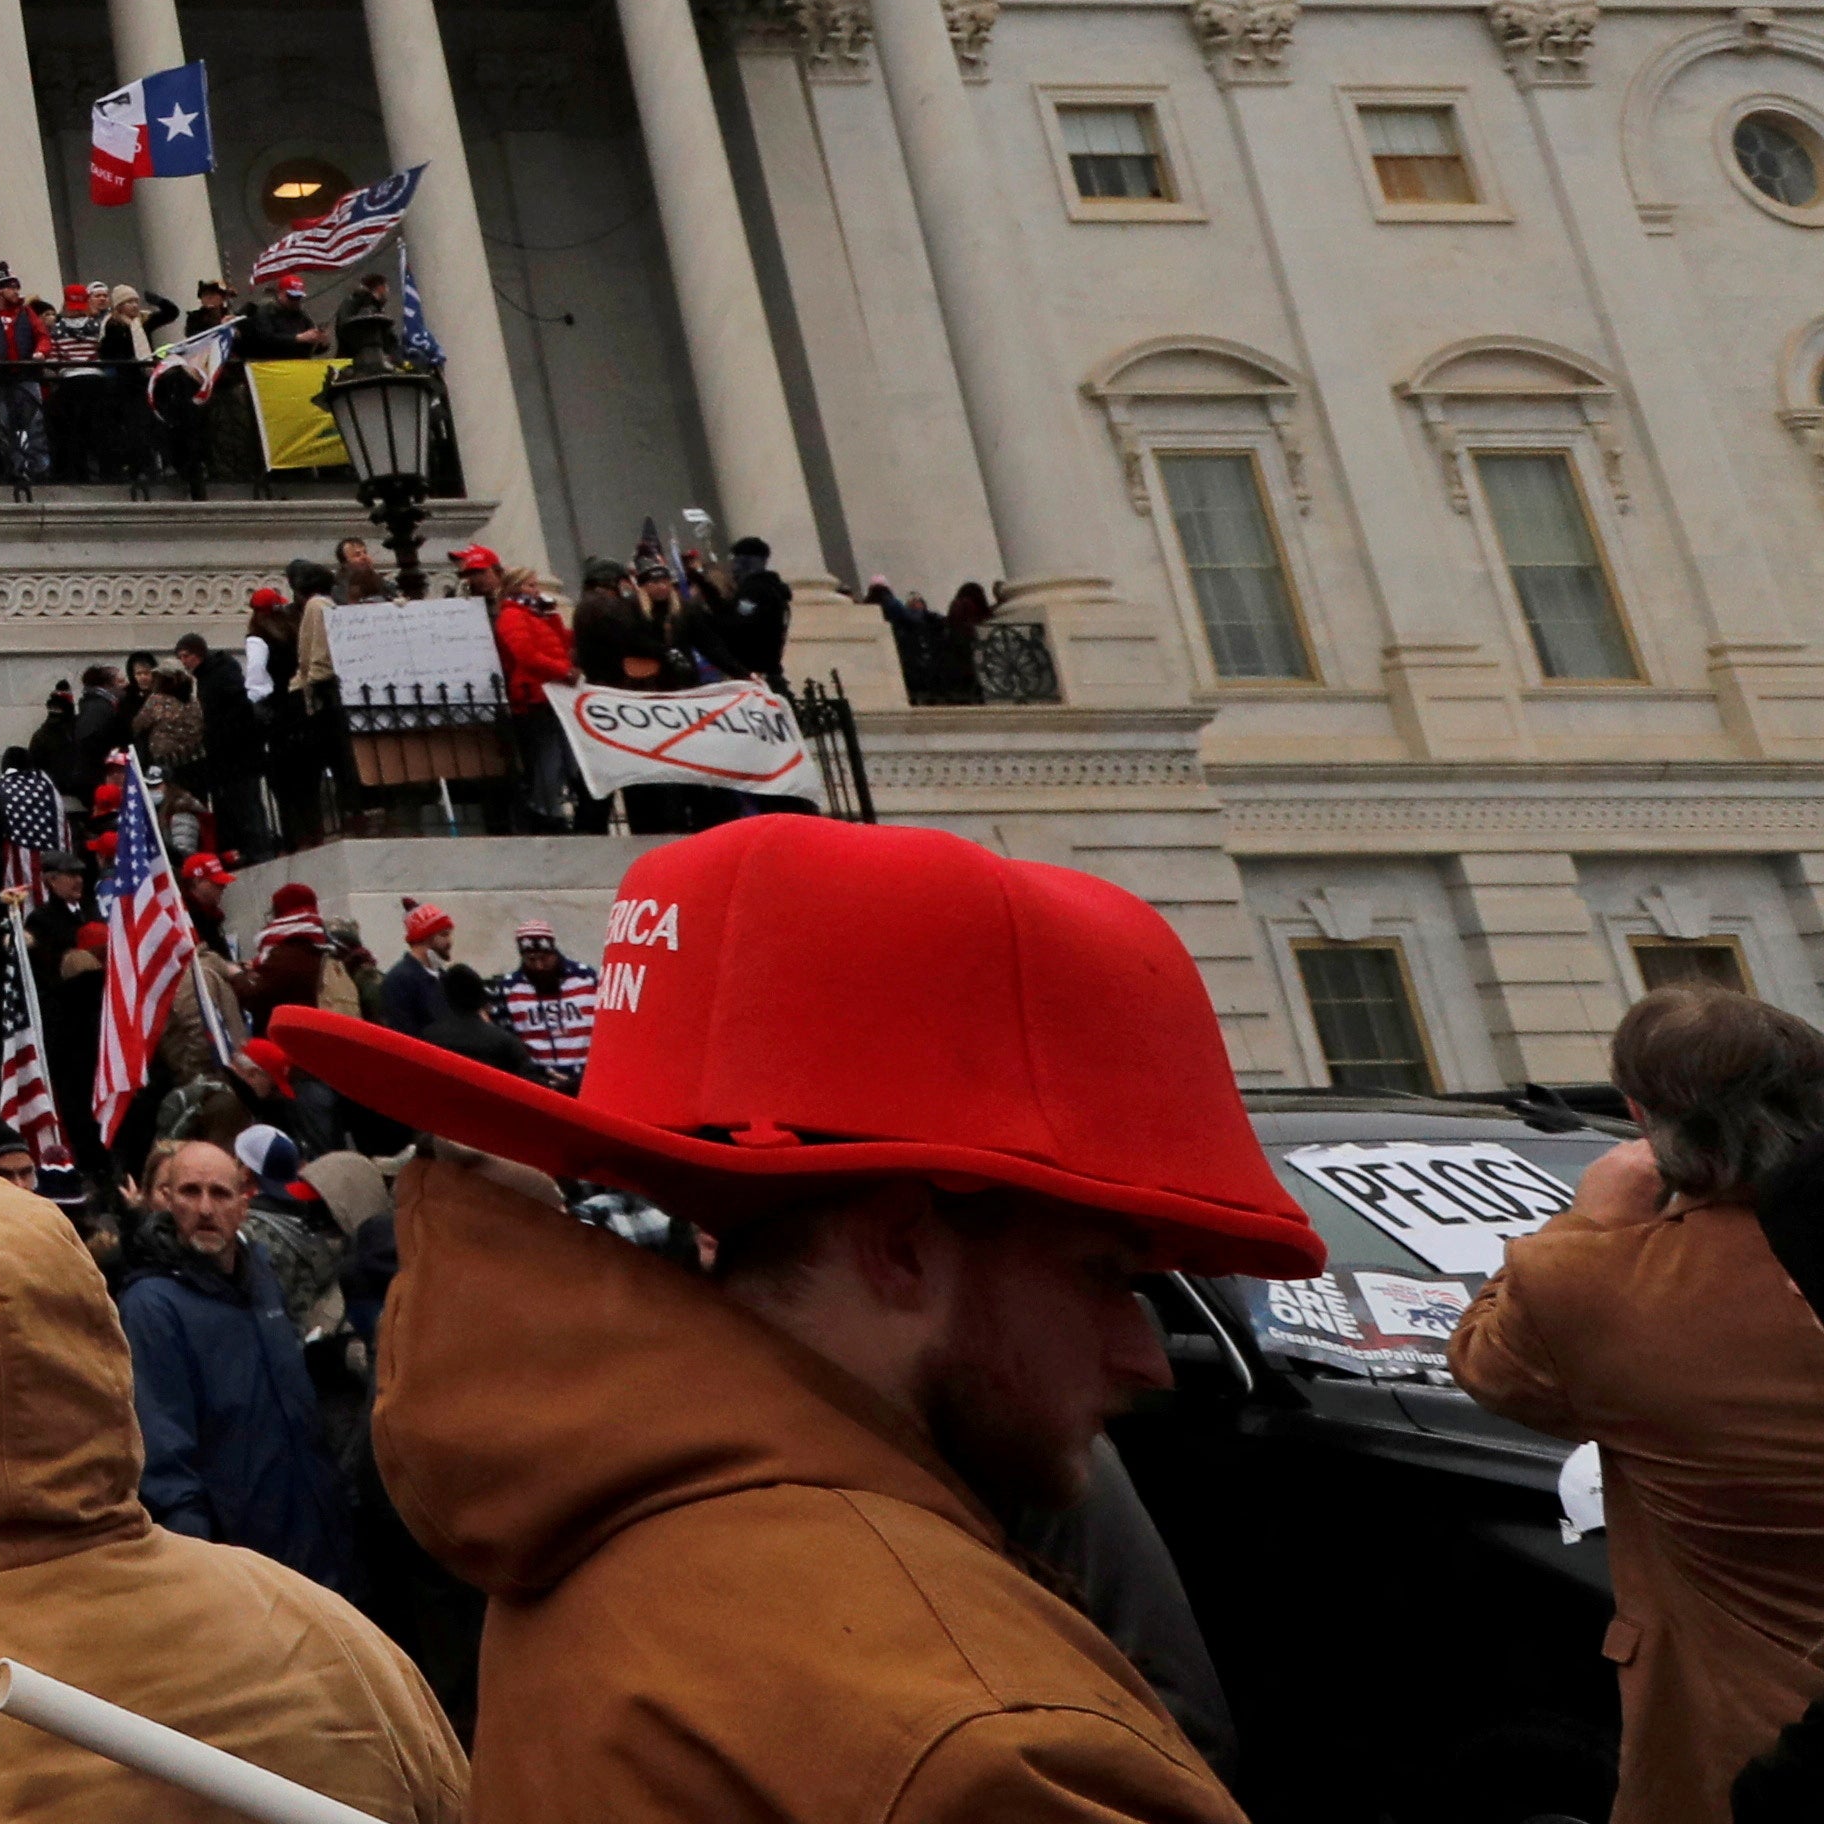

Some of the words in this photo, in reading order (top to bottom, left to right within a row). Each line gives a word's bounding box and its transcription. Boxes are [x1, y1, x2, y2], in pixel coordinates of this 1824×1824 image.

[587, 704, 797, 745] SOCIALISM
[527, 1001, 583, 1030] USA
[1317, 1158, 1577, 1229] PELOSI
[1268, 1282, 1351, 1319] ARE
[1268, 1302, 1365, 1341] ONE.
